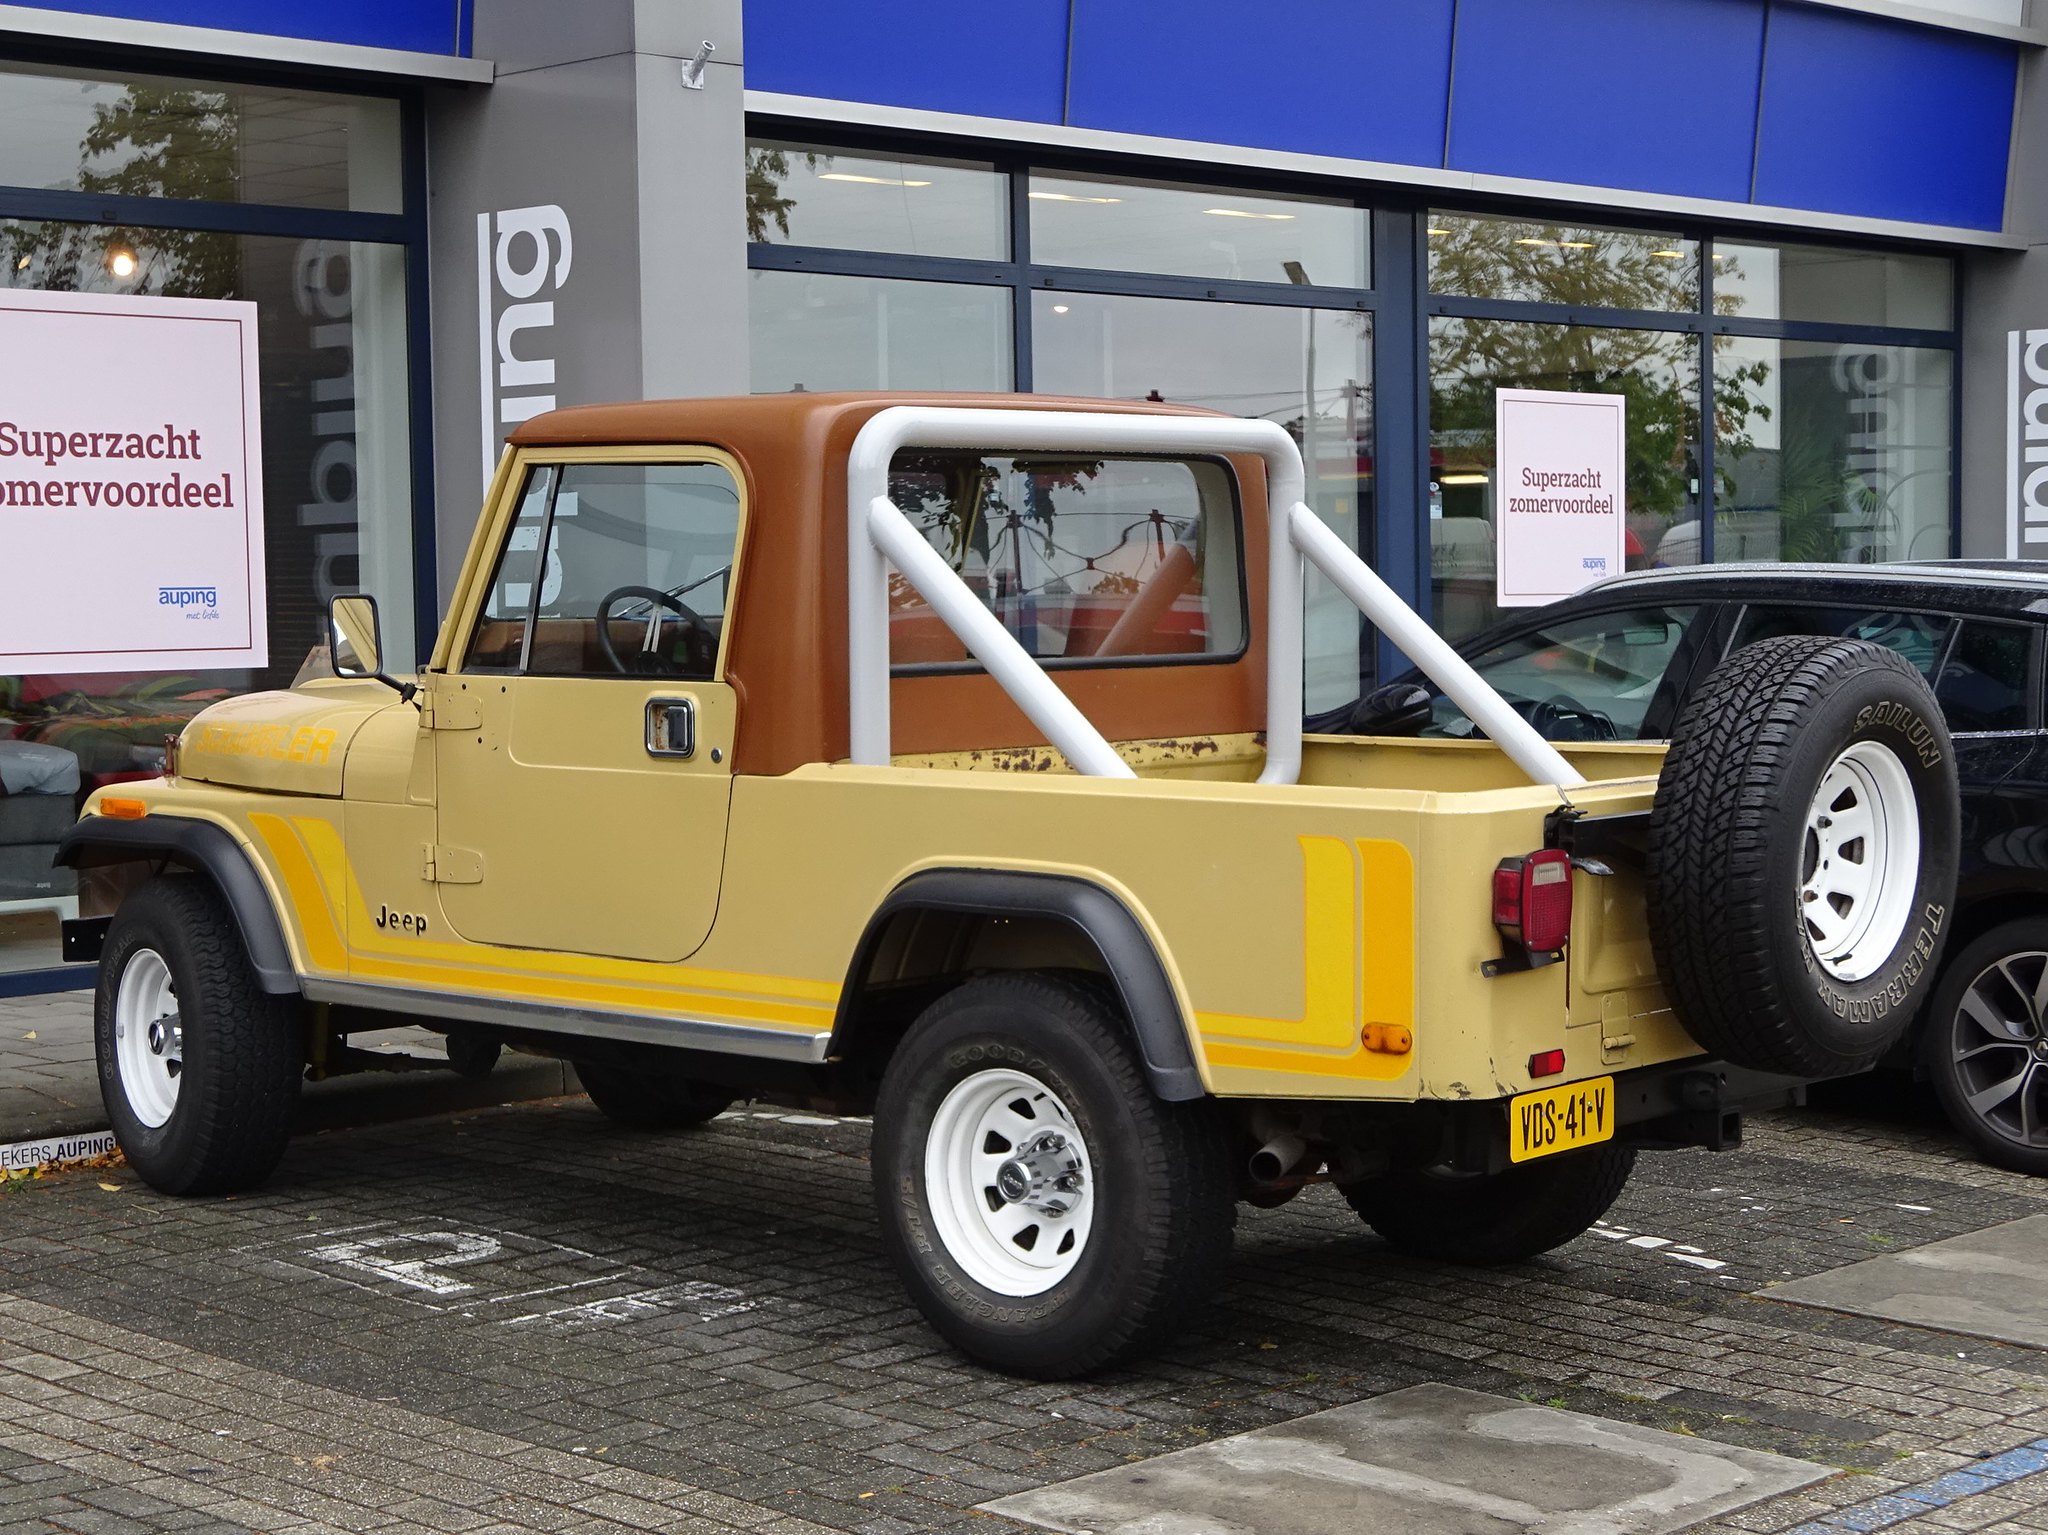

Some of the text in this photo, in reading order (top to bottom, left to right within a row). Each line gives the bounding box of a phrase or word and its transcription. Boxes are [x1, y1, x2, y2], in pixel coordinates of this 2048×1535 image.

[0, 422, 201, 466] Superzacht
[0, 472, 234, 507] mervoordeel
[1522, 467, 1602, 492] Superzacht
[1510, 494, 1614, 514] zomervoordeel
[158, 587, 216, 608] auping
[194, 720, 337, 766] SCLER
[1853, 701, 1942, 769] SAILUN
[376, 905, 427, 935] Jeep
[1817, 903, 1945, 1024] TERRAMAX
[1521, 1087, 1605, 1151] VDS-41-V
[1, 1136, 115, 1166] EKERS AUPING
[932, 1263, 1070, 1324] WRANGLER
